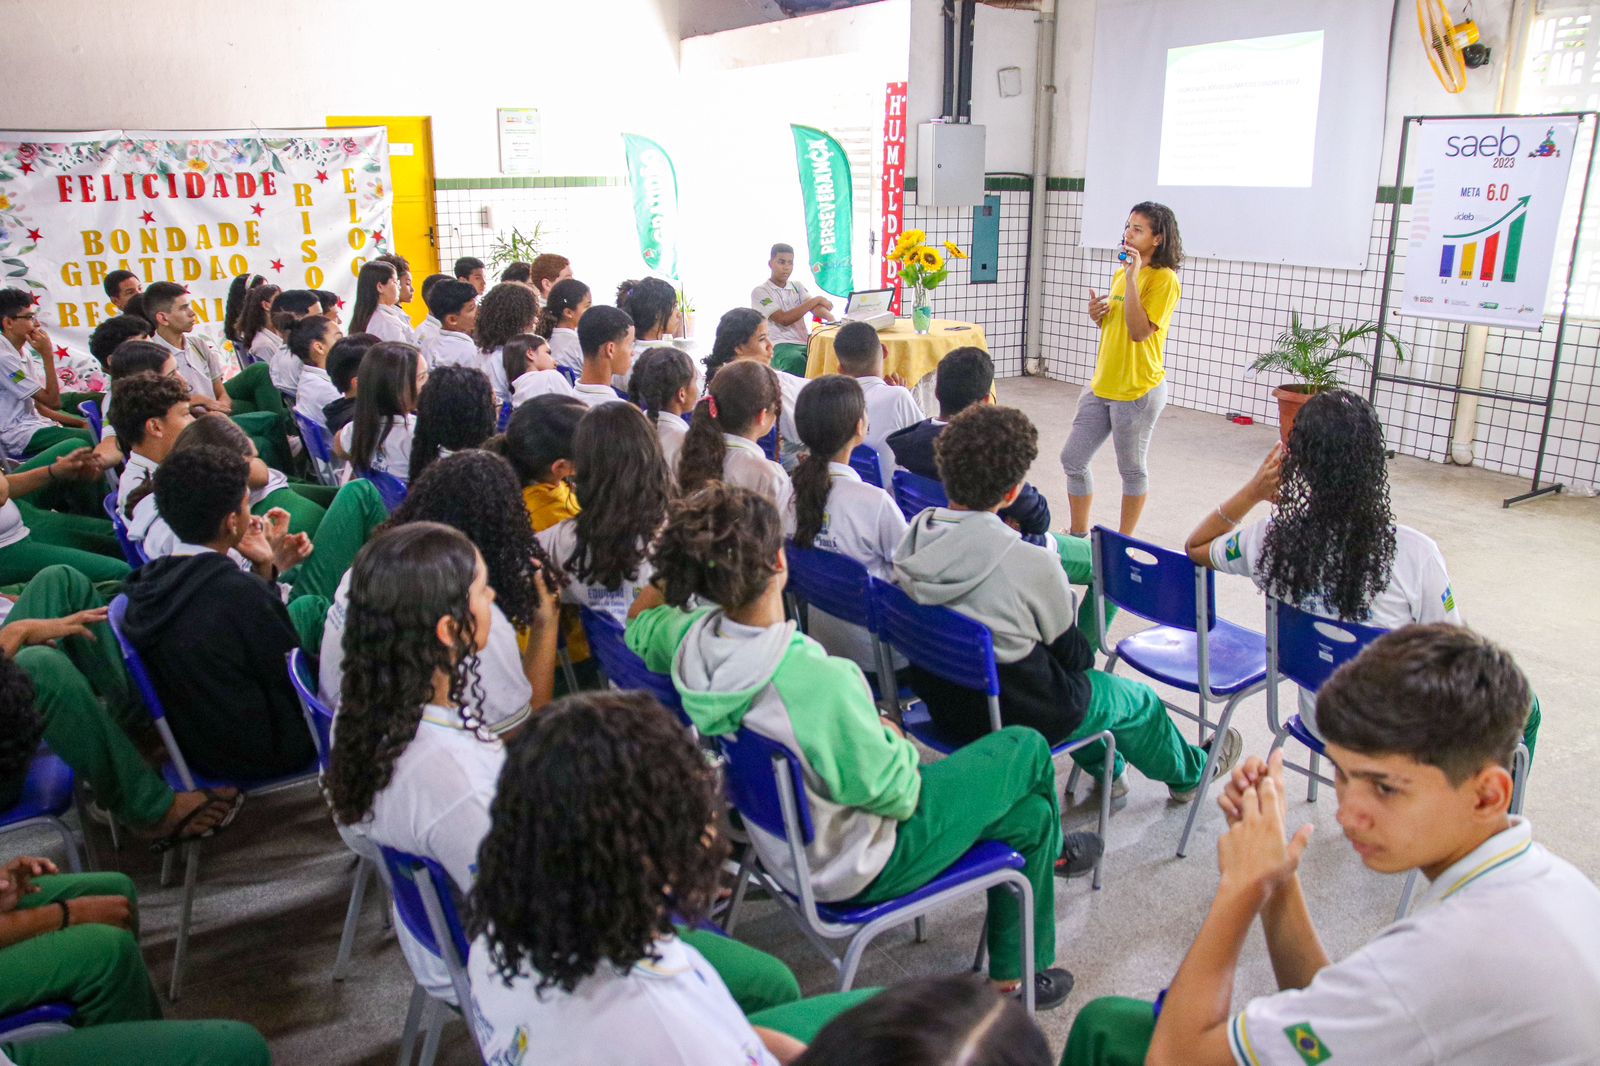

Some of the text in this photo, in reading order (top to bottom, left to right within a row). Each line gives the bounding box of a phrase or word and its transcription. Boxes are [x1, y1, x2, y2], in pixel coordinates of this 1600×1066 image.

[1445, 126, 1520, 157] saeb
[1493, 157, 1515, 168] 2023
[56, 171, 278, 203] FELICIDADE
[804, 137, 837, 256] PERSEVERANÇA
[1460, 183, 1509, 201] META 6.0
[80, 220, 261, 256] BONDADE
[293, 183, 325, 290] RISO
